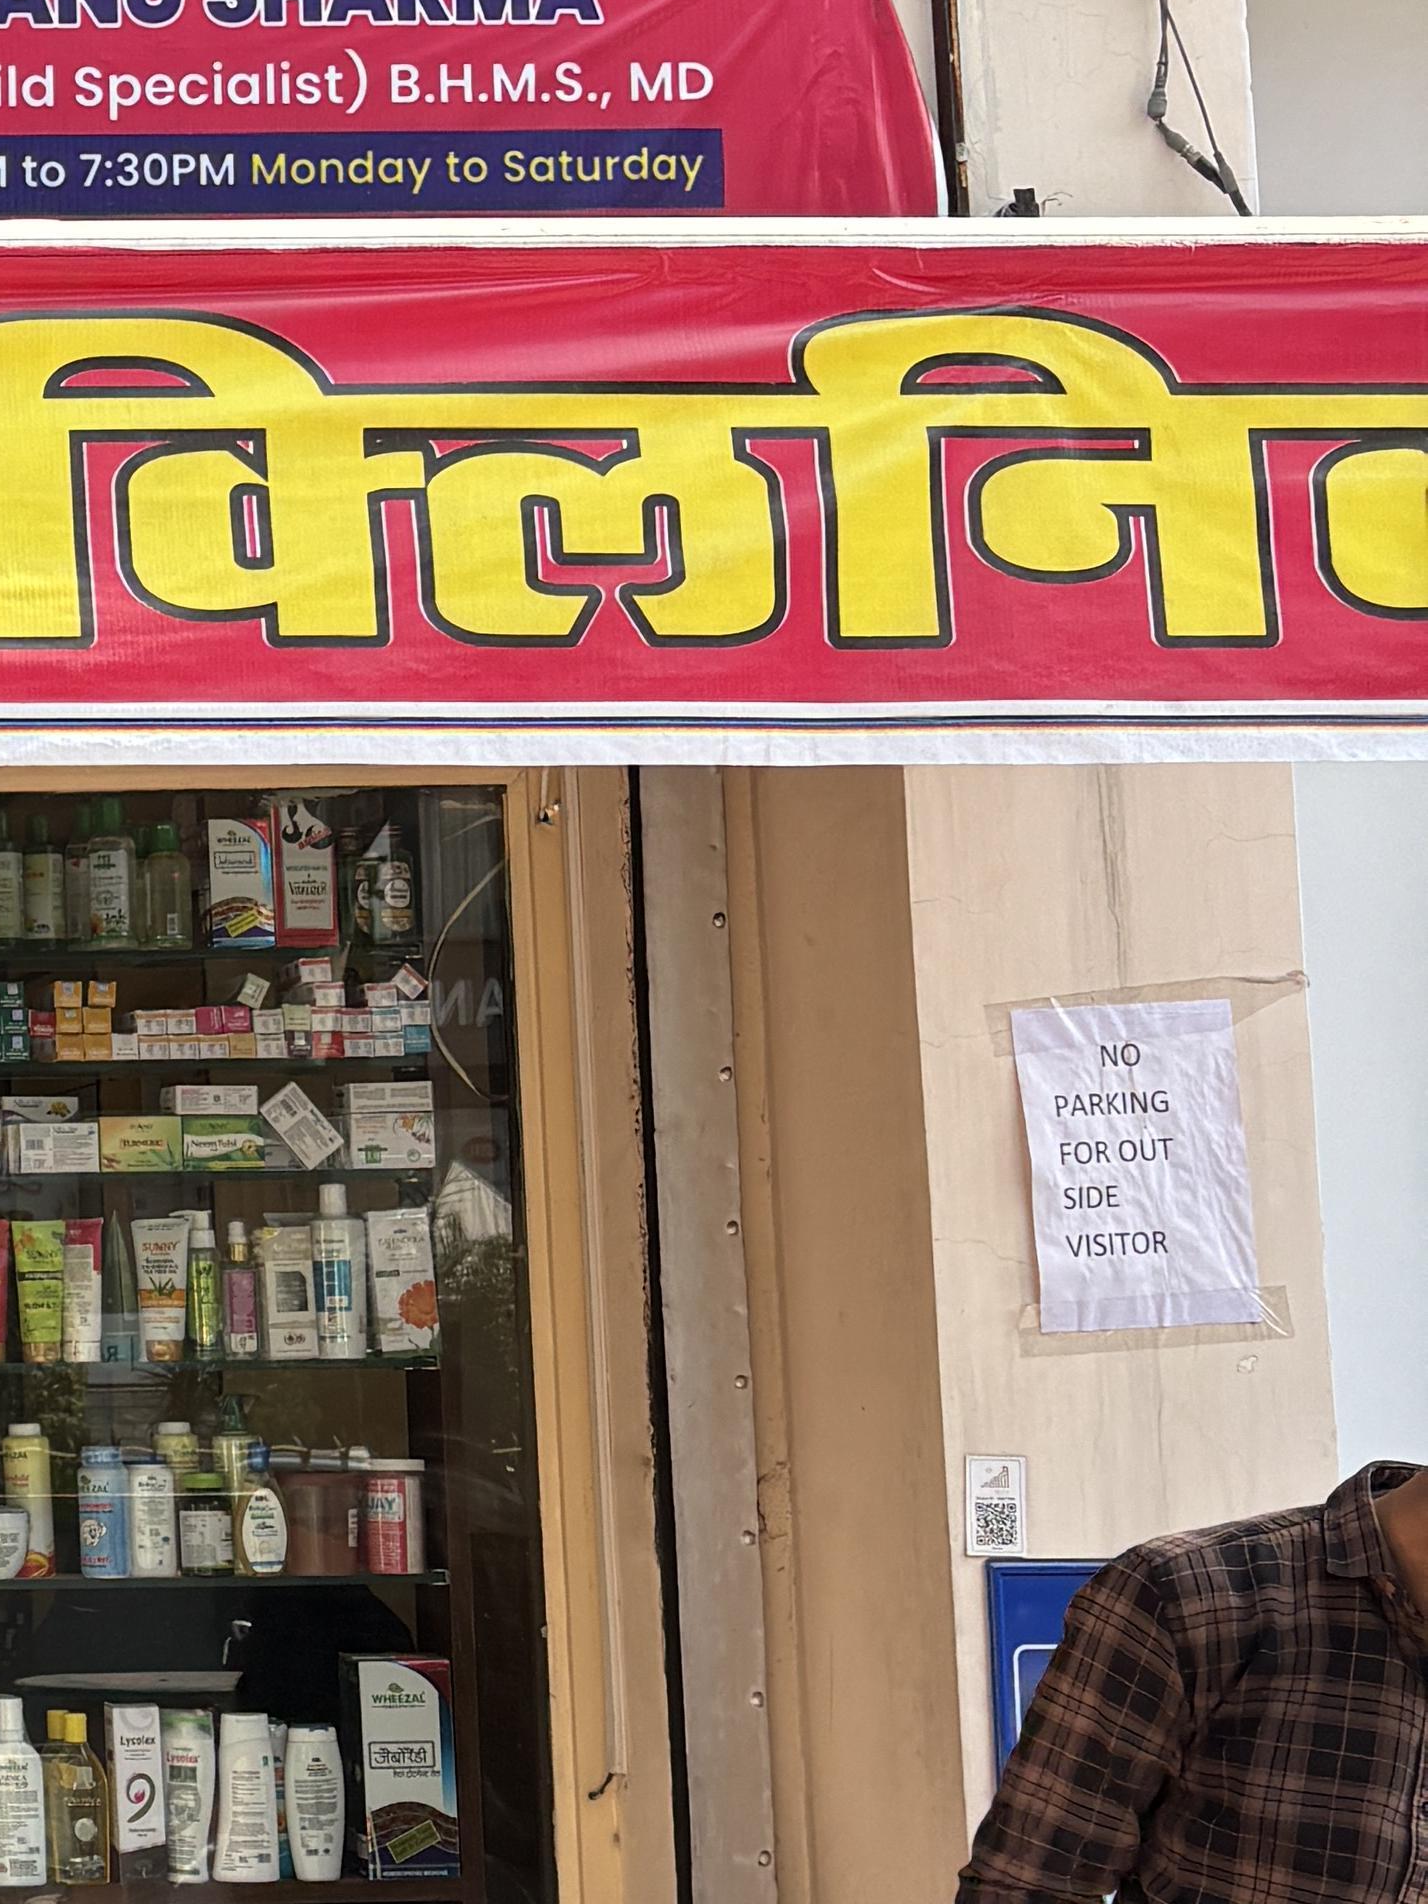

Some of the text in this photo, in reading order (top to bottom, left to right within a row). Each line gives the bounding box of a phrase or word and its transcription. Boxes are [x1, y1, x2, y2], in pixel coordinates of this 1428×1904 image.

[74, 47, 368, 123] Specialist)
[630, 60, 715, 102] MD
[22, 154, 66, 189] to
[79, 152, 236, 188] 7:30PM
[250, 150, 430, 196] Monday
[446, 151, 484, 184] to
[502, 147, 705, 193] Saturday
[1100, 1042, 1141, 1068] NO
[1054, 1090, 1170, 1118] PARKING
[1059, 1138, 1174, 1166] FOR OUT
[1063, 1185, 1120, 1210] SIDE
[1065, 1231, 1169, 1258] VISITOR
[371, 1693, 426, 1704] WHEEZAL
